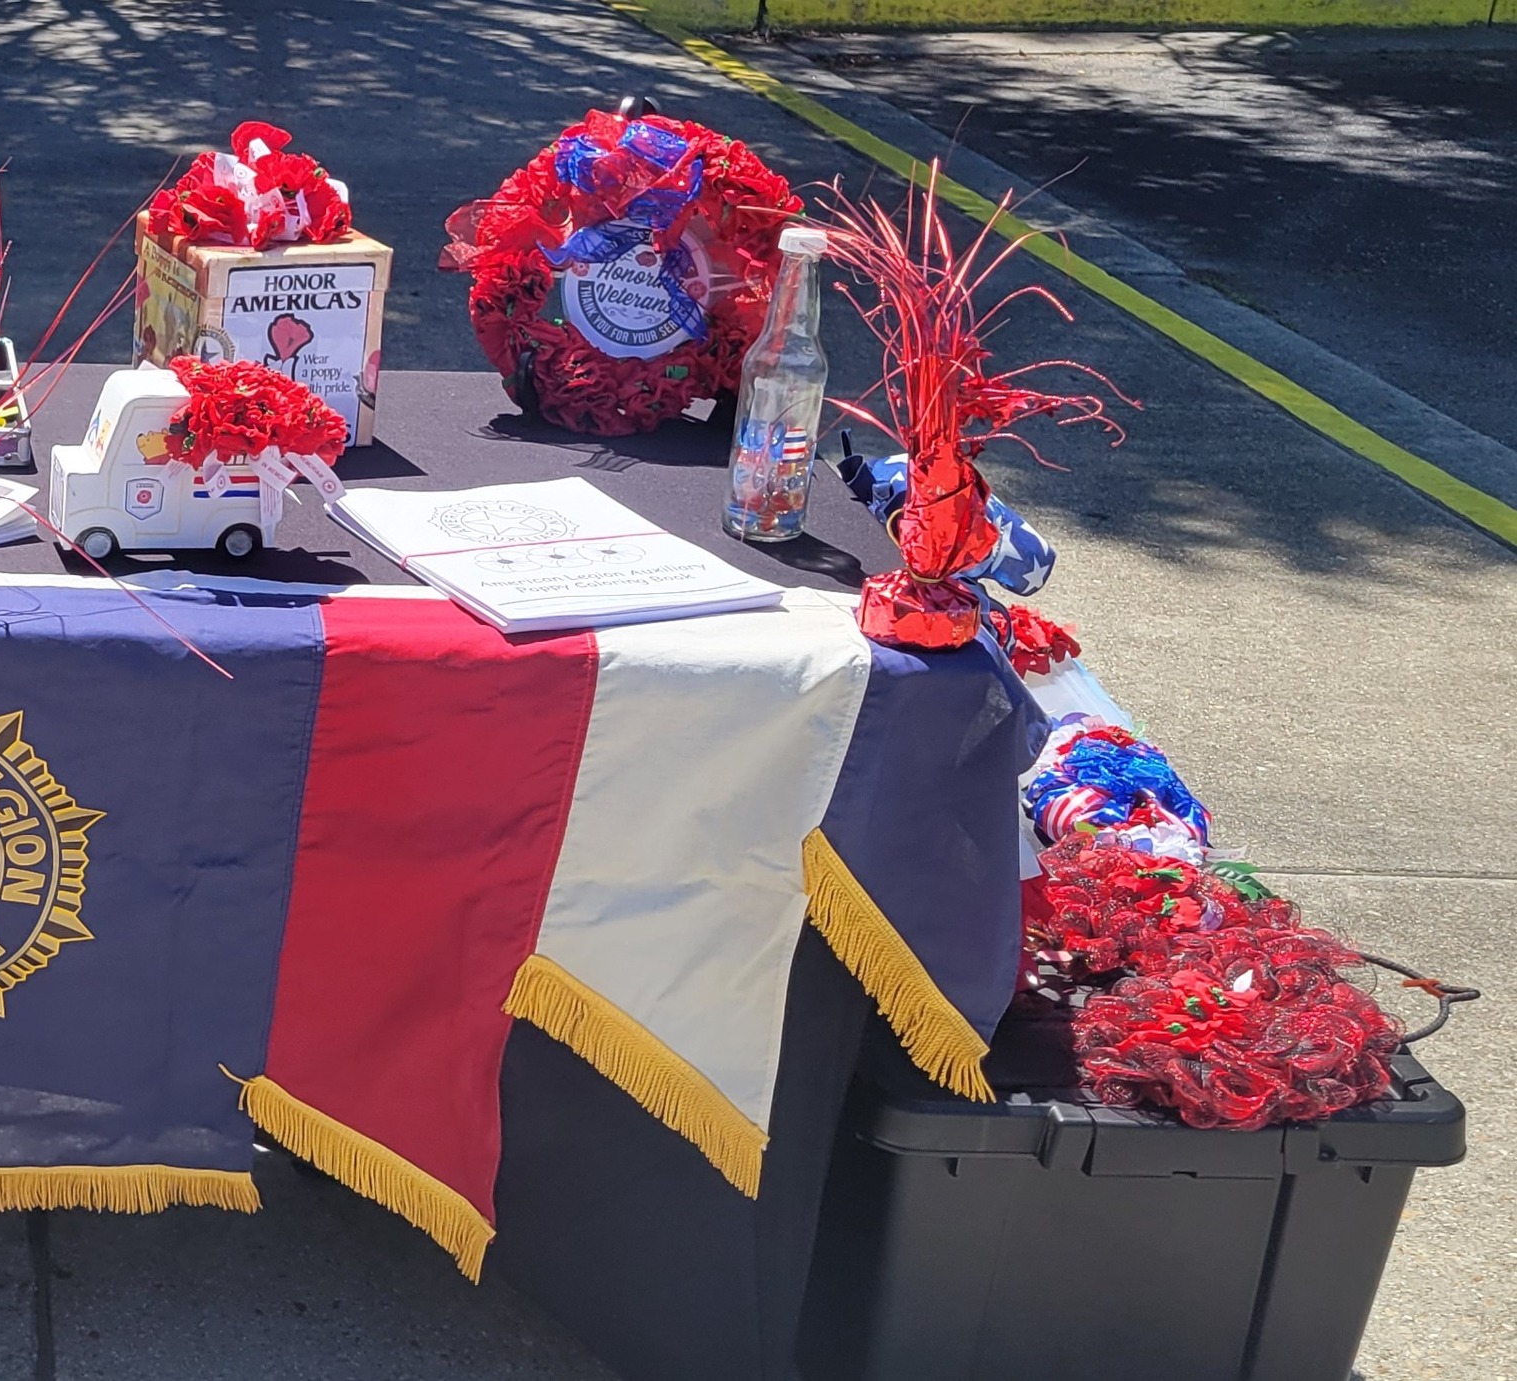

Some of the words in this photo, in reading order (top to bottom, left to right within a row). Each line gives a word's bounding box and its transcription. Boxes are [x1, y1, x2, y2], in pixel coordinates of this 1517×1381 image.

[264, 272, 336, 292] HONOR
[596, 282, 672, 314] Veterans
[580, 285, 596, 318] THANK
[594, 315, 610, 333] YOU
[611, 327, 629, 343] FOR
[633, 330, 658, 344] YOUR
[302, 354, 330, 365] Wear
[302, 369, 307, 377] a
[310, 368, 342, 381] poppy
[308, 383, 322, 394] ith
[480, 574, 563, 588] American
[565, 570, 626, 583] Legion
[515, 582, 571, 594] Poppy
[574, 576, 649, 589] Coloring
[653, 572, 697, 583] Book
